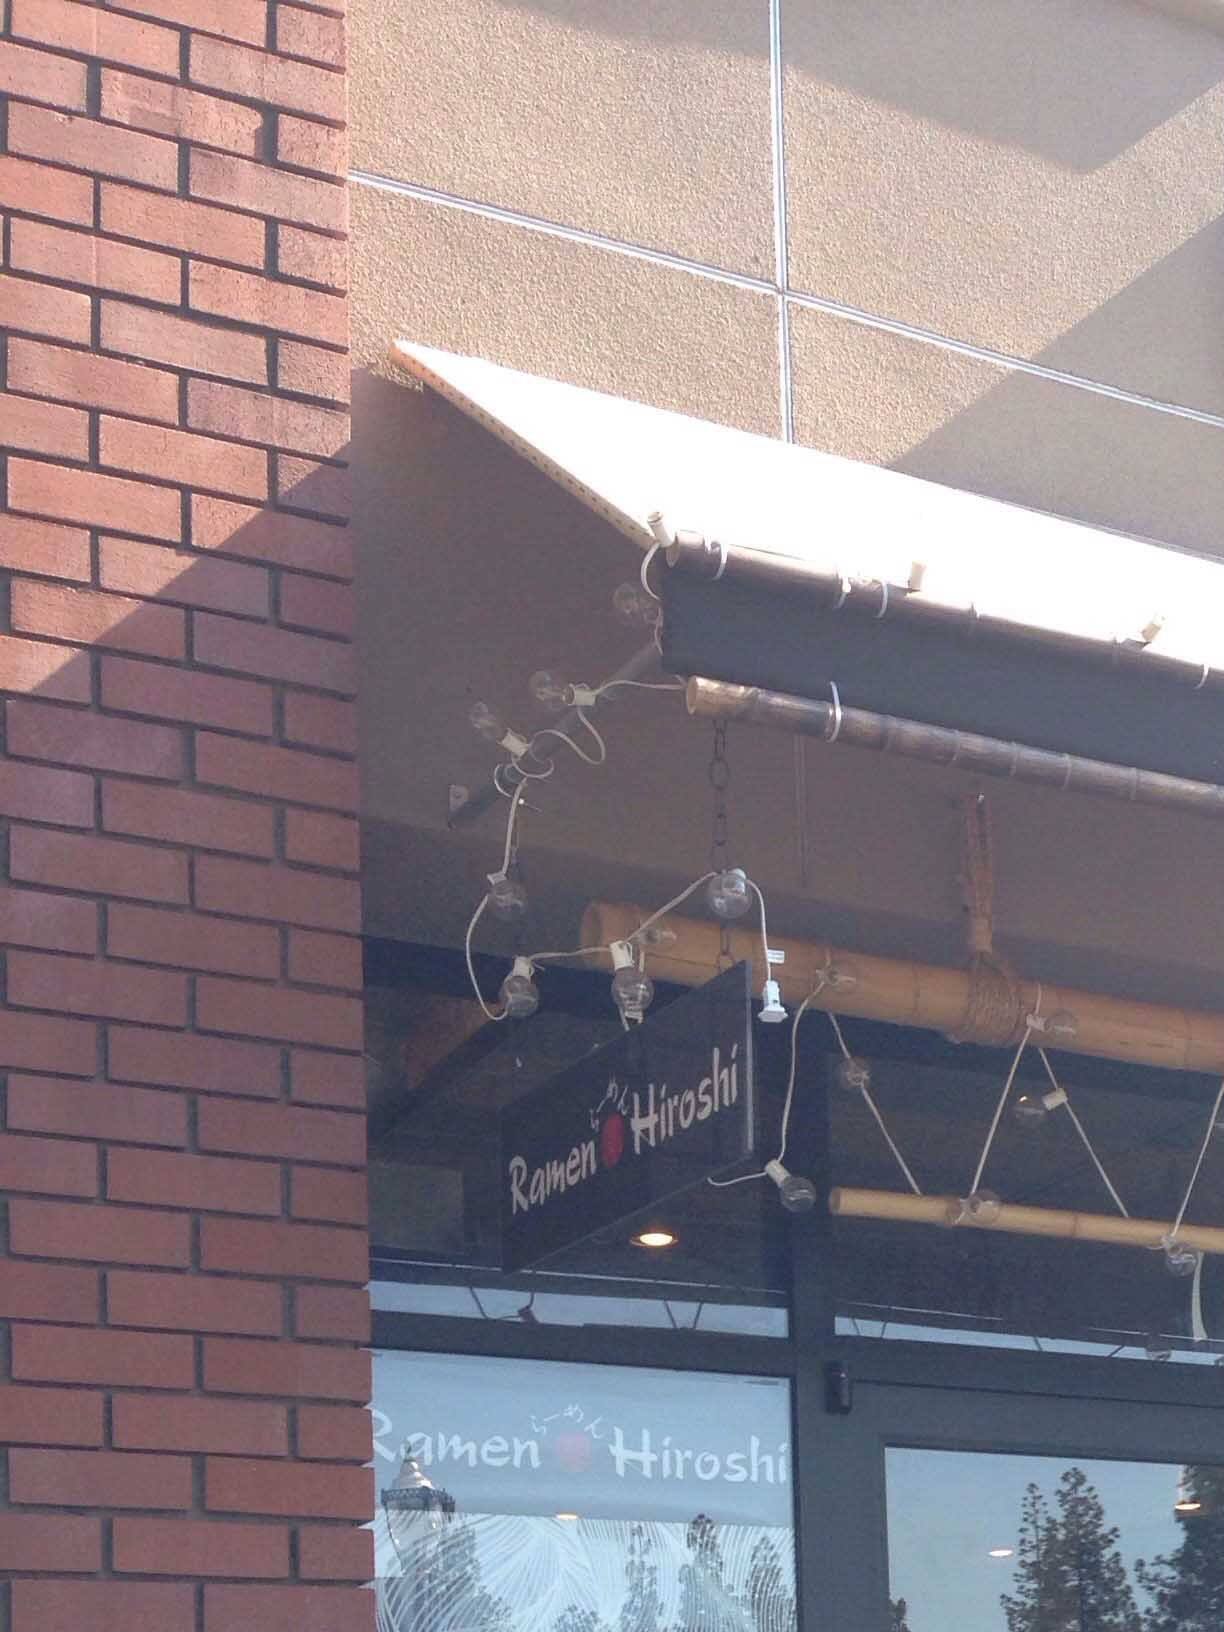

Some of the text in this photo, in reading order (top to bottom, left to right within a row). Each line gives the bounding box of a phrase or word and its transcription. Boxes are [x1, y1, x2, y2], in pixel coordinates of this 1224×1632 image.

[509, 1043, 739, 1215] Ramen Hiroshi
[372, 1408, 790, 1484] Ramen Hiroshi
